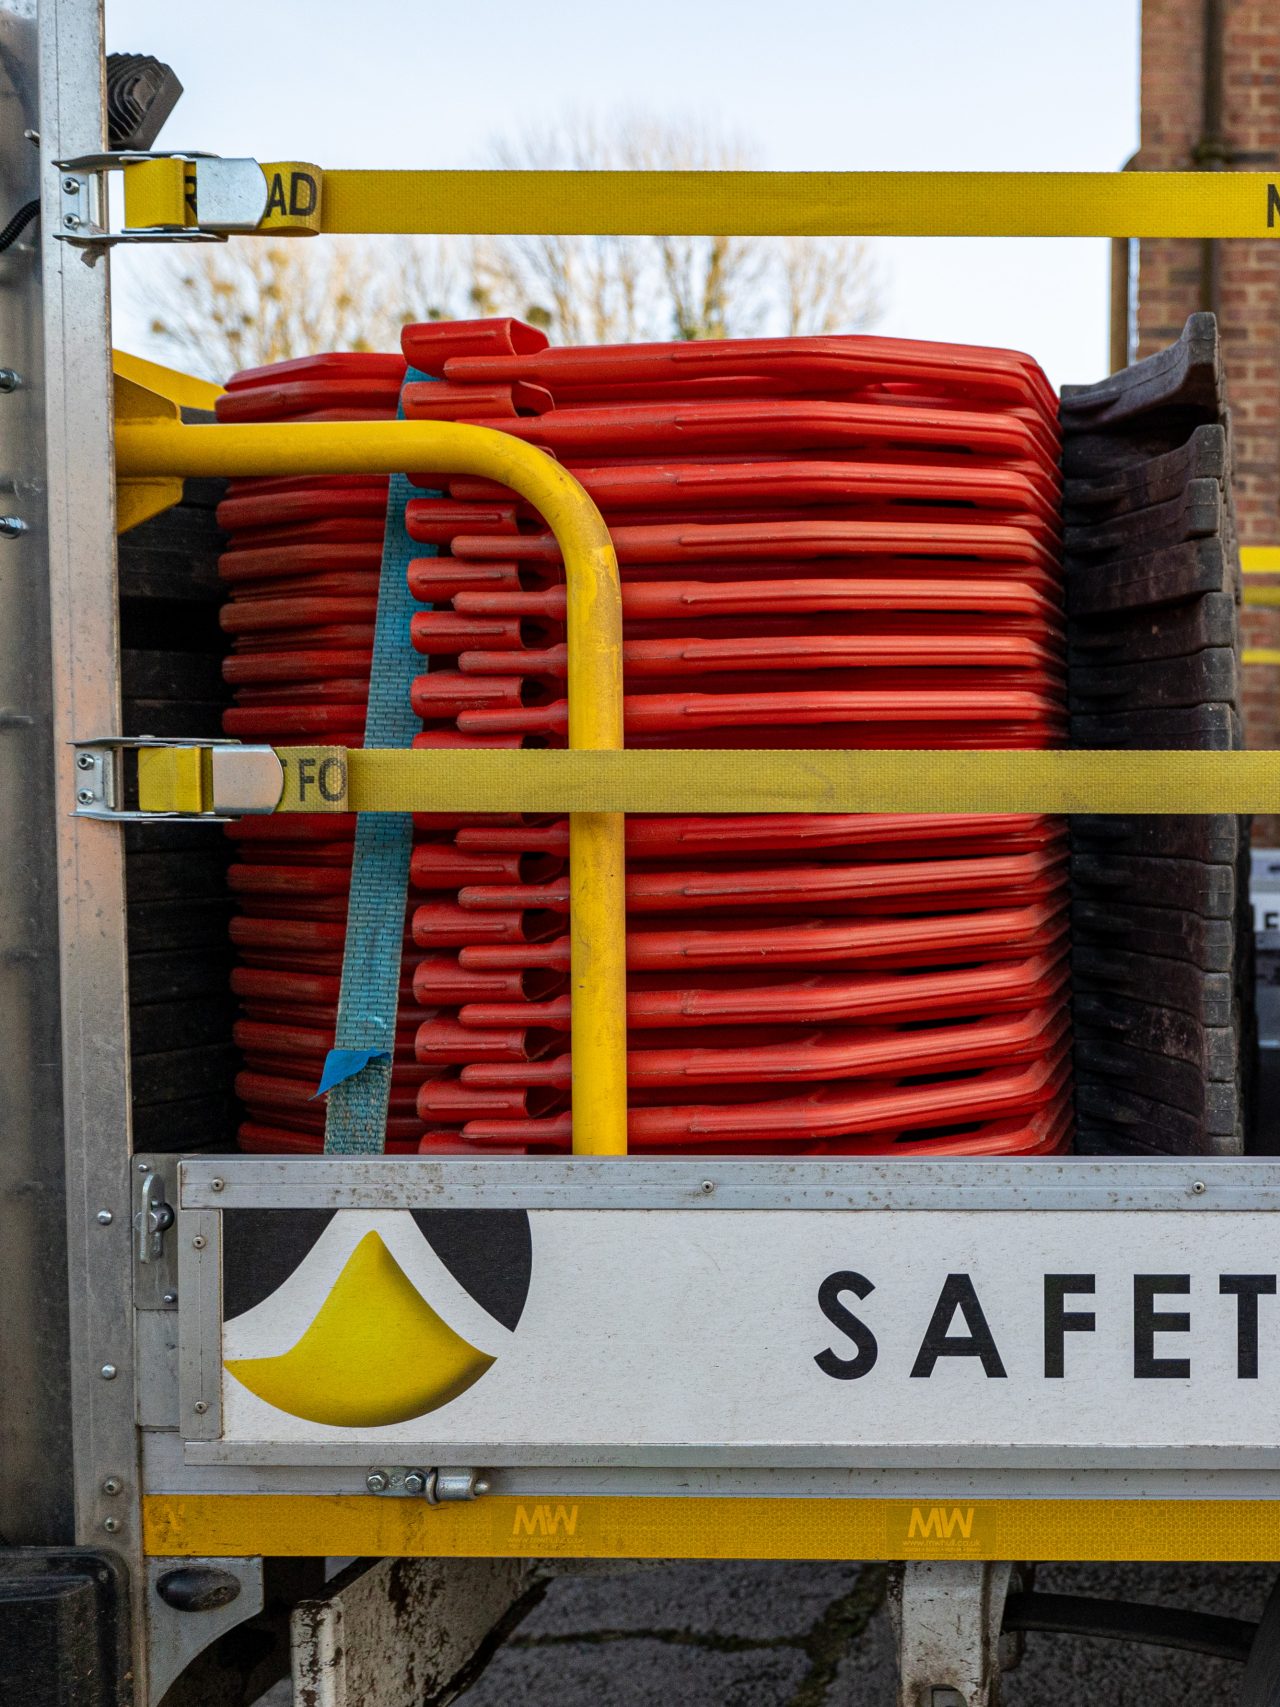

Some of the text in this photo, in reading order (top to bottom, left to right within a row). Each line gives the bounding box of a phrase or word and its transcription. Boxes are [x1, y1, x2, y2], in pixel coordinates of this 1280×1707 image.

[266, 171, 317, 218] AD
[299, 758, 346, 802] FO
[513, 1504, 578, 1535] MW
[908, 1507, 974, 1538] MW
